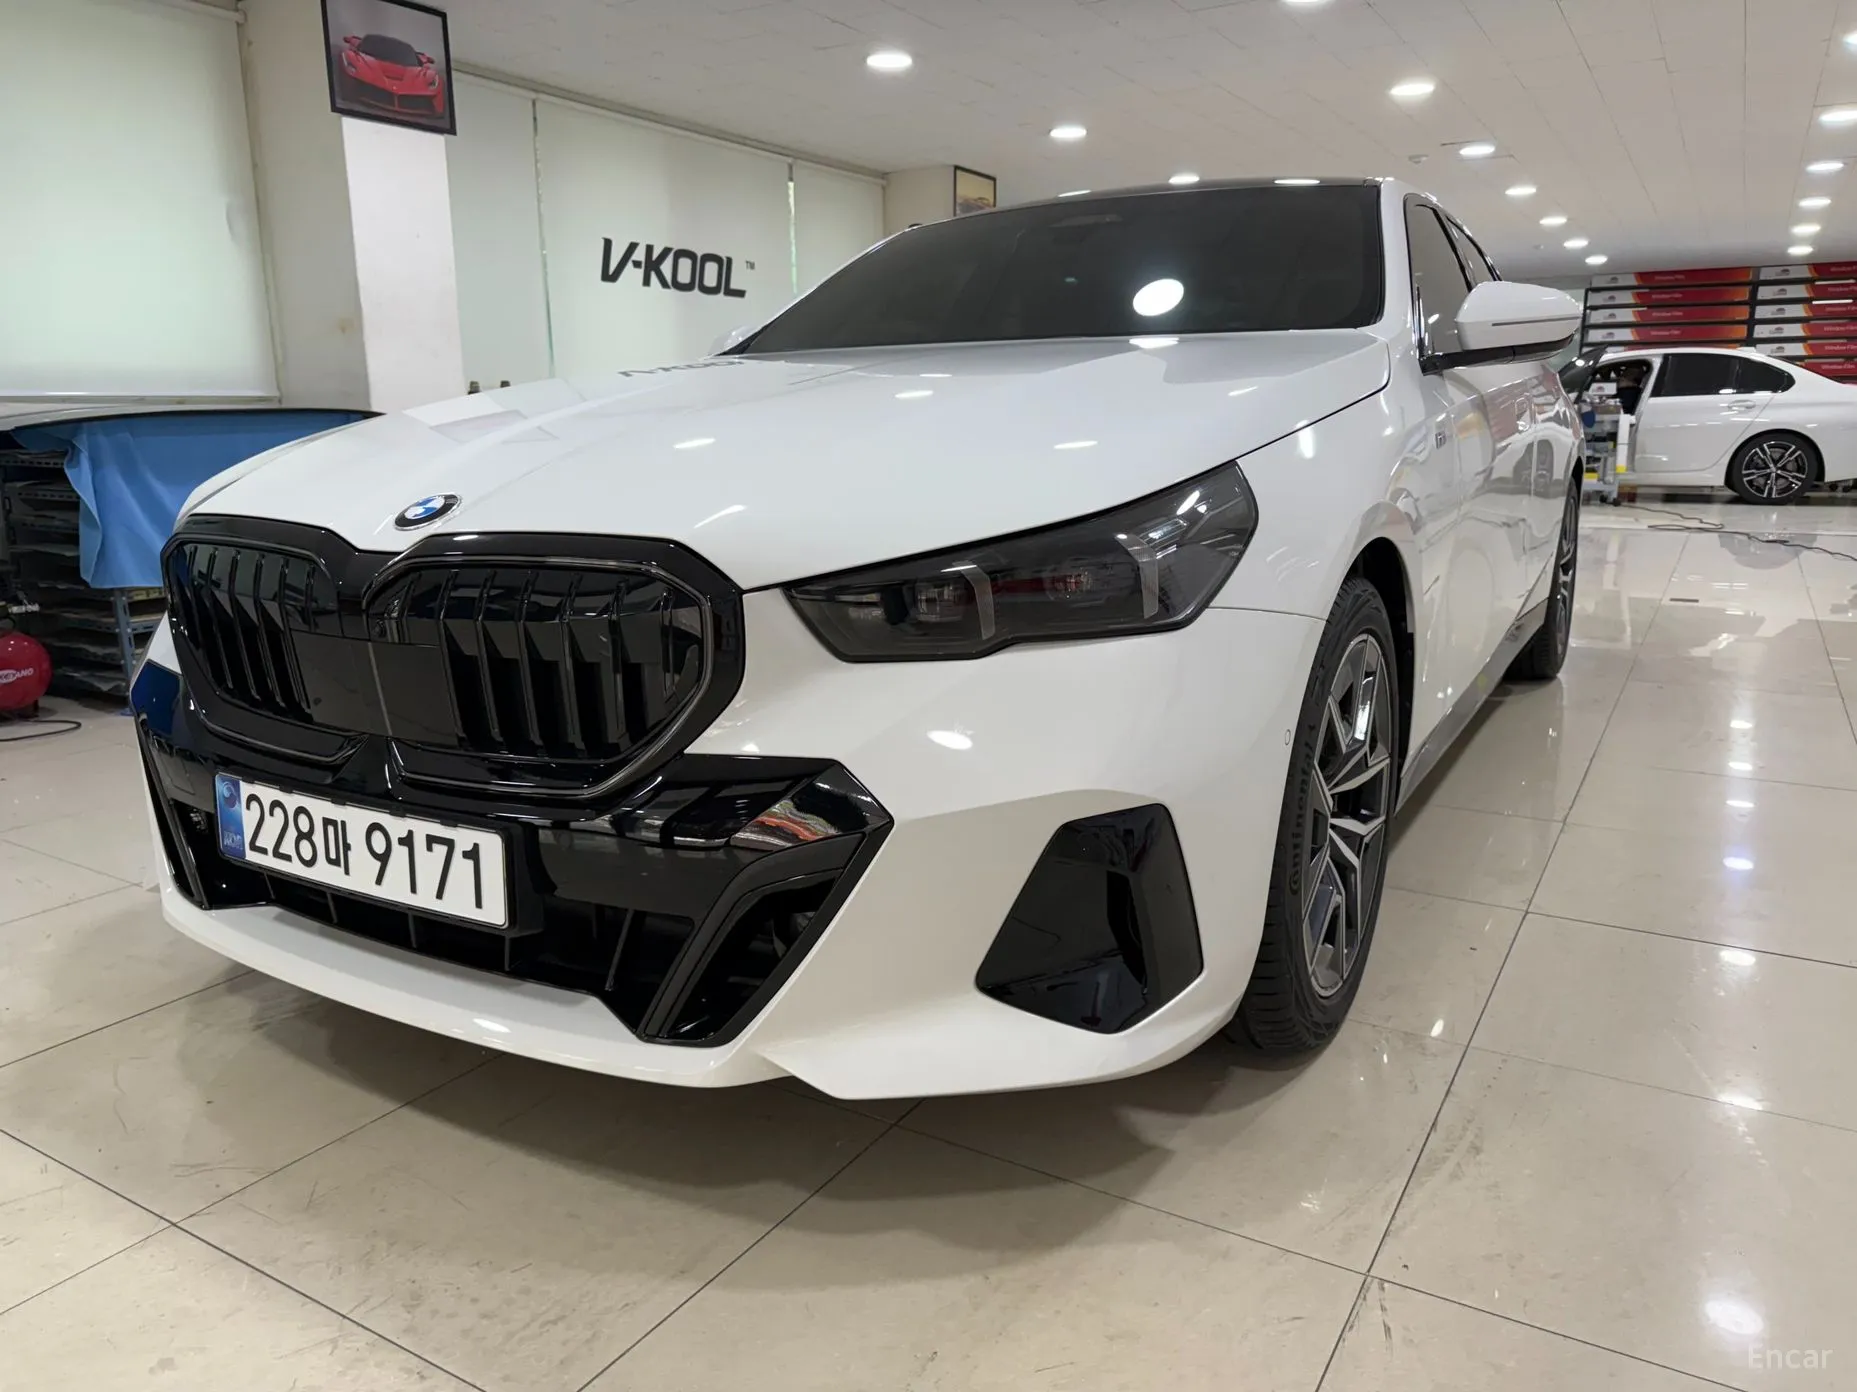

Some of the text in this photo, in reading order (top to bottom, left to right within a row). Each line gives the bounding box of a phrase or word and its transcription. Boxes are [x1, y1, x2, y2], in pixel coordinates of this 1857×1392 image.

[600, 237, 747, 298] V-KOOL
[245, 793, 484, 910] 228마 9171
[1289, 741, 1314, 896] Continental
